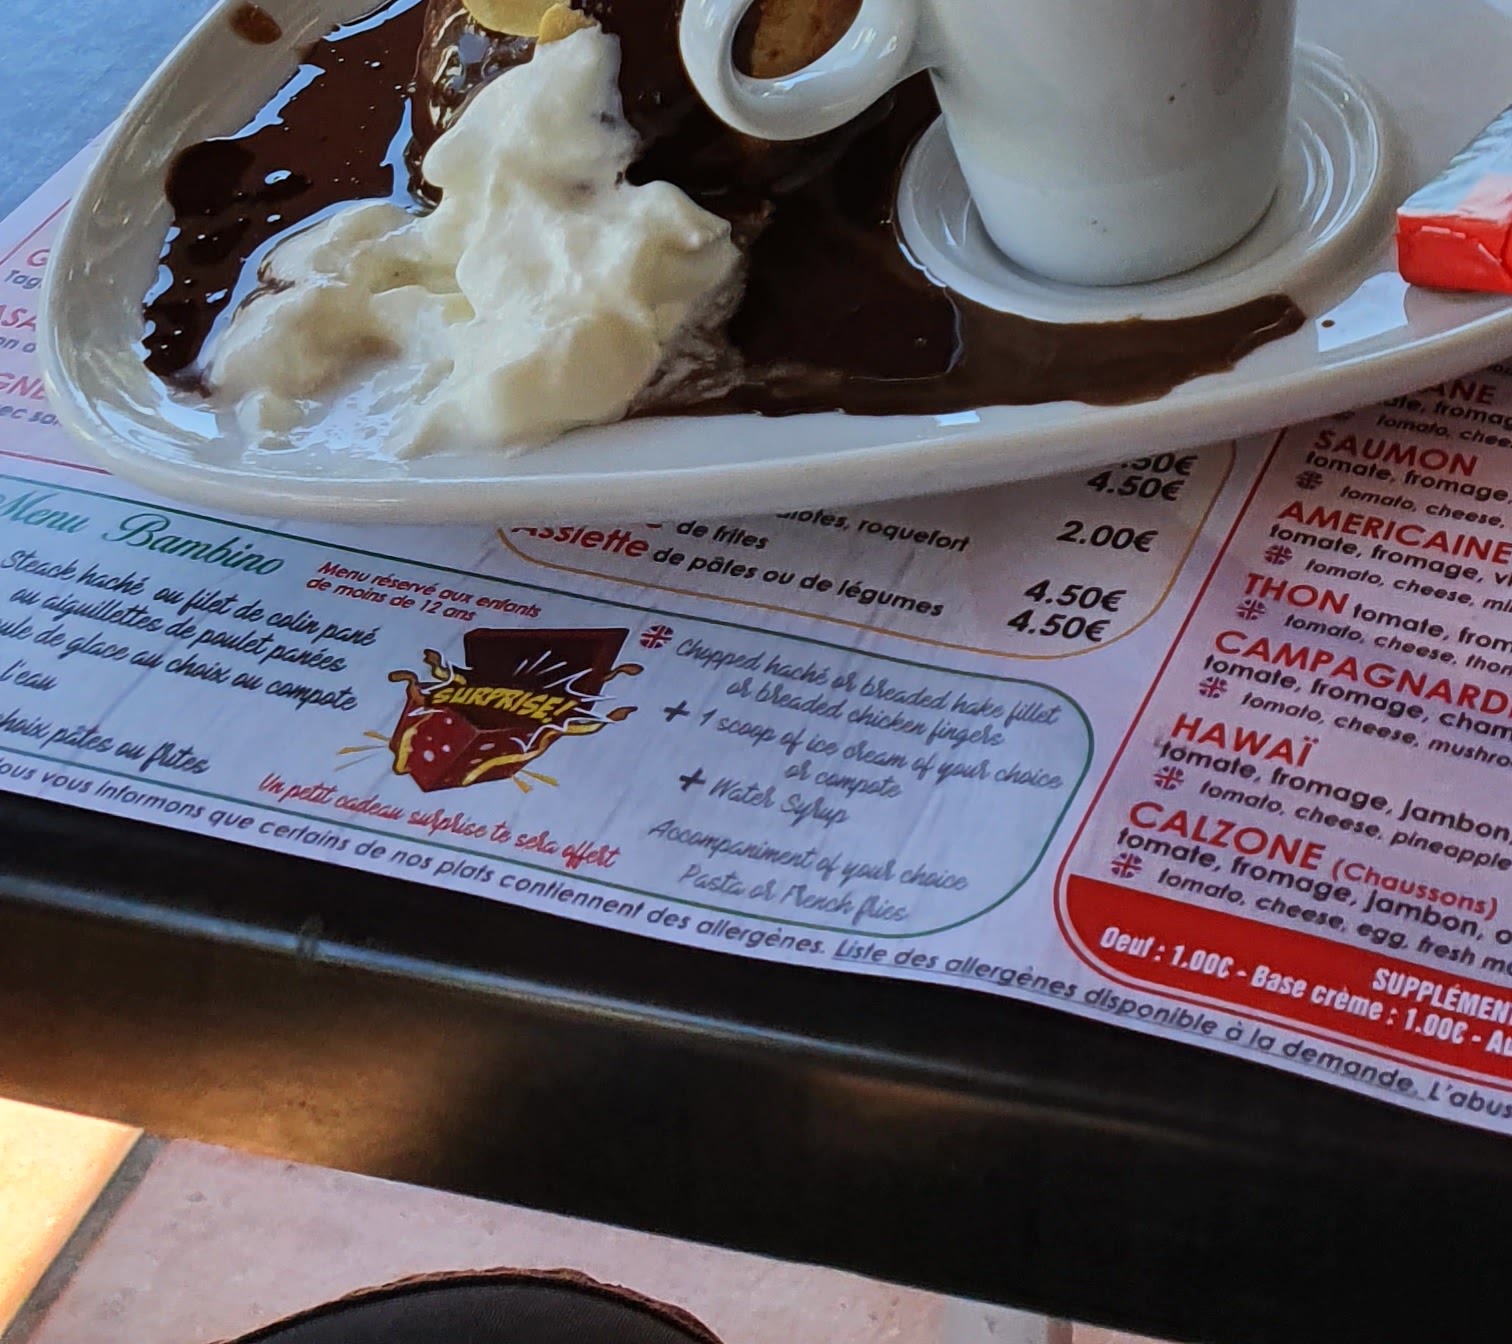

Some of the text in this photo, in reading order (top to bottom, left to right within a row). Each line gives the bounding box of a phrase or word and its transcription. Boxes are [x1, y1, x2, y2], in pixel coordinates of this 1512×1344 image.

[1305, 452, 1396, 484] tomate,
[1312, 430, 1479, 477] SAUMON
[102, 513, 285, 576] Bambino
[1056, 520, 1159, 553] 2.00€
[1269, 524, 1363, 560] tomate,
[1371, 544, 1485, 585] fromage,
[76, 563, 150, 596] haché
[153, 587, 184, 604] ou
[178, 588, 239, 616] filet
[232, 600, 264, 623] de
[266, 609, 319, 636] colin
[316, 624, 381, 647] pané
[1024, 578, 1127, 613] 4.50€
[1242, 573, 1350, 614] THON
[1353, 603, 1450, 643] tomate,
[1006, 610, 1111, 643] 4.50€
[432, 685, 578, 724] SURPRISE!
[1170, 712, 1320, 768] HAWAÏ
[1117, 827, 1223, 874] tomate,
[1231, 857, 1358, 908] fromage,
[1363, 889, 1485, 941] jambon,
[1129, 800, 1498, 921] CALZONE (Chaussons)
[1100, 925, 1152, 960] Oeuf
[1170, 942, 1235, 978] 1.00€
[1250, 965, 1307, 1000] Base
[1310, 983, 1383, 1022] crème
[1403, 1008, 1465, 1045] 1.00€
